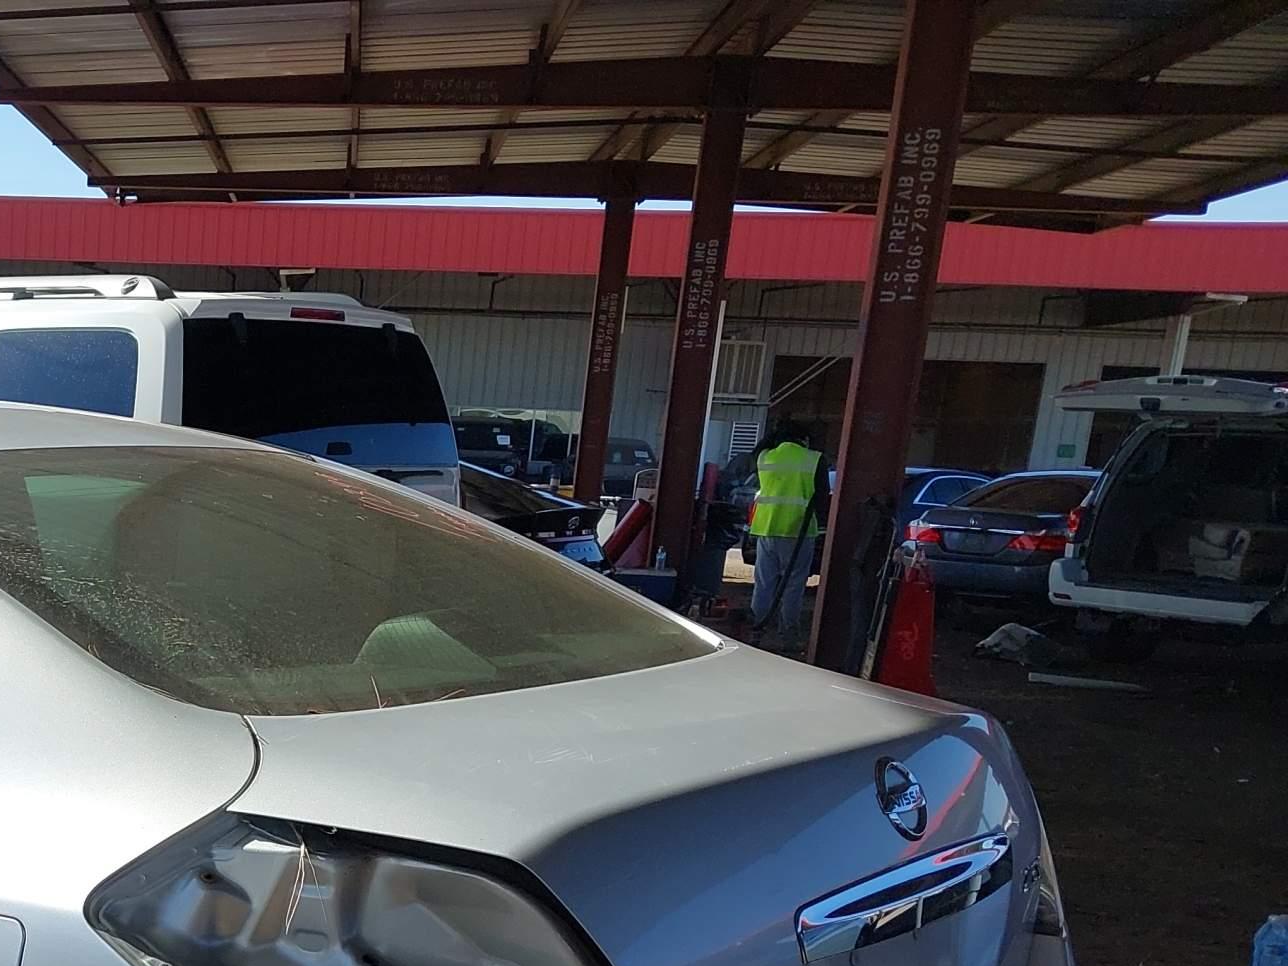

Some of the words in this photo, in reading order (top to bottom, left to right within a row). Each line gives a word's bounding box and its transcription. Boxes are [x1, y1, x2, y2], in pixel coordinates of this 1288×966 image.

[887, 175, 915, 253] PREFAB
[899, 127, 942, 301] 1-866-799-0969
[686, 269, 703, 319] PREFAB
[880, 265, 902, 302] U.S.
